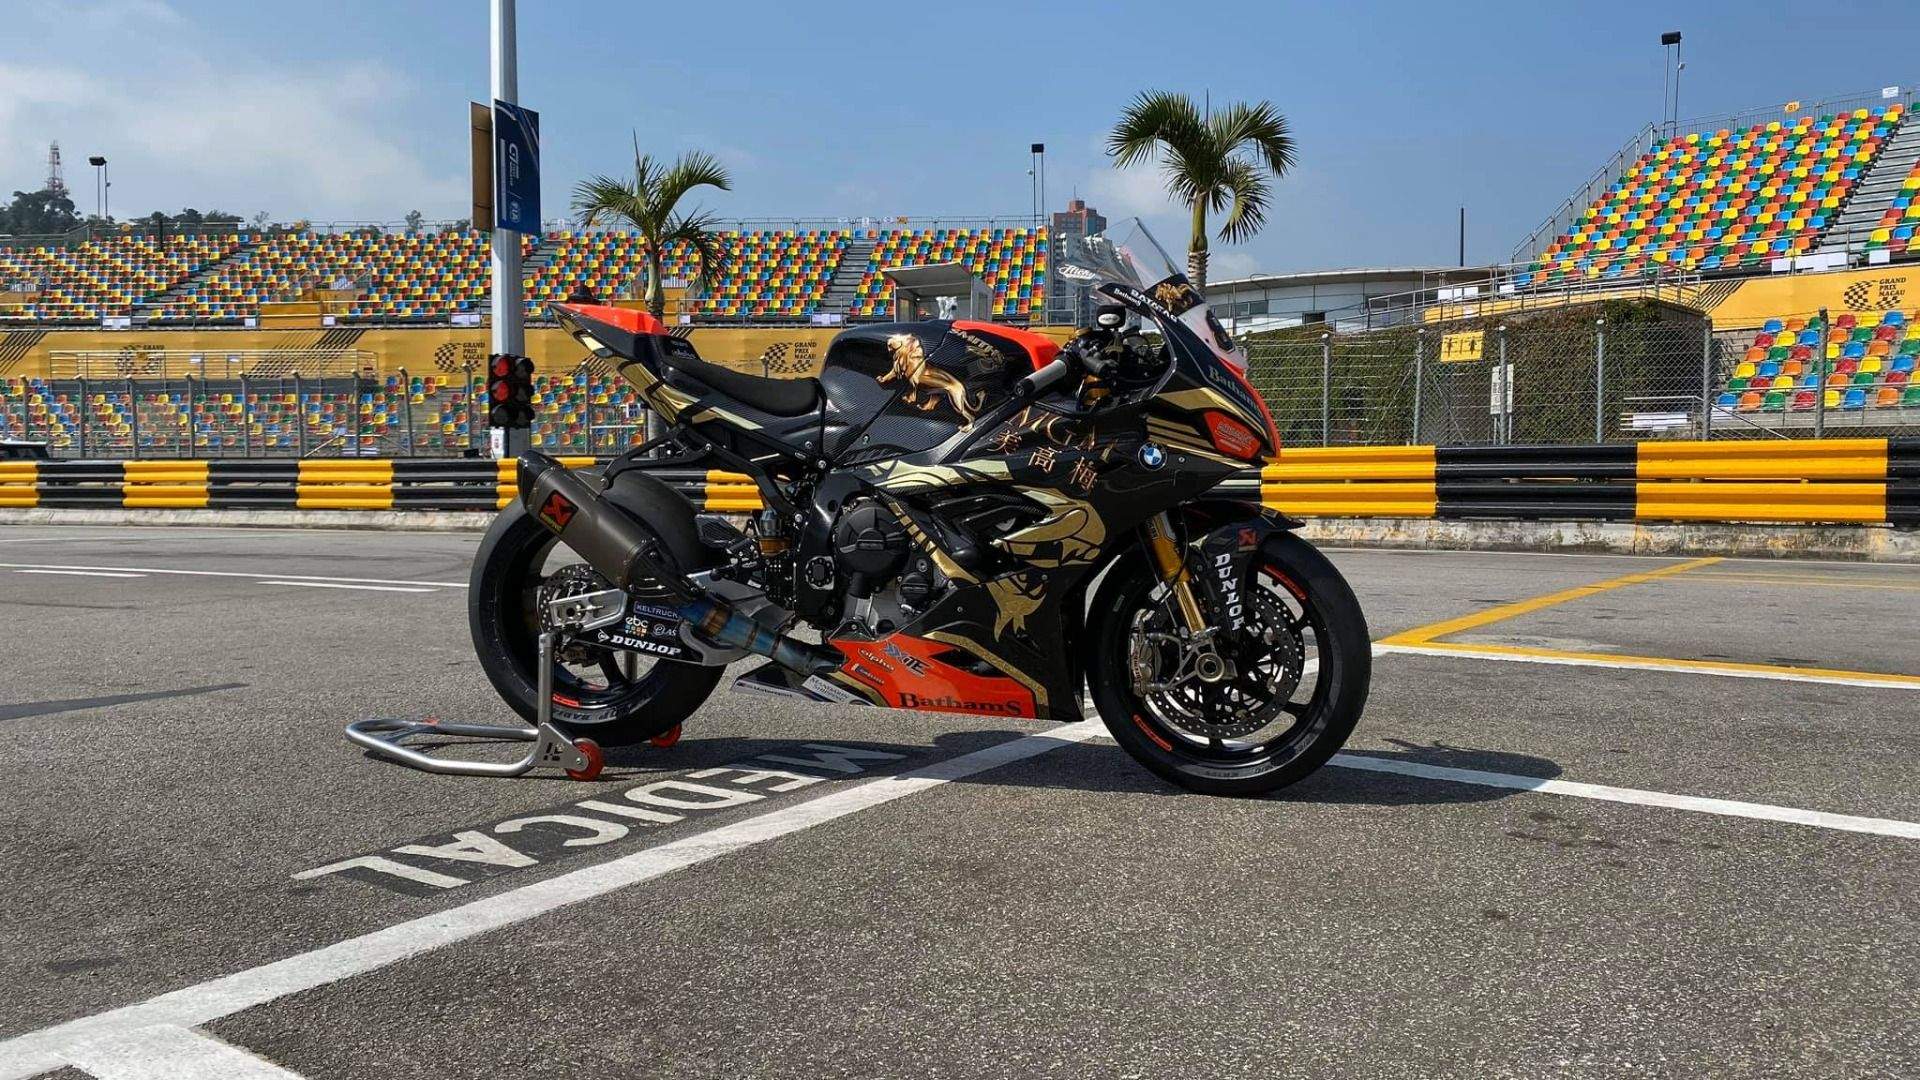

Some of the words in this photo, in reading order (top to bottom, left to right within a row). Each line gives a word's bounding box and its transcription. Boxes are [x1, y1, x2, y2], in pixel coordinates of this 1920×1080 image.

[986, 430, 1099, 495] 美高梅
[625, 614, 649, 628] ebc
[1214, 553, 1246, 631] DUNLOP
[610, 634, 682, 656] DUNLOP
[291, 743, 908, 889] MEDICAL
